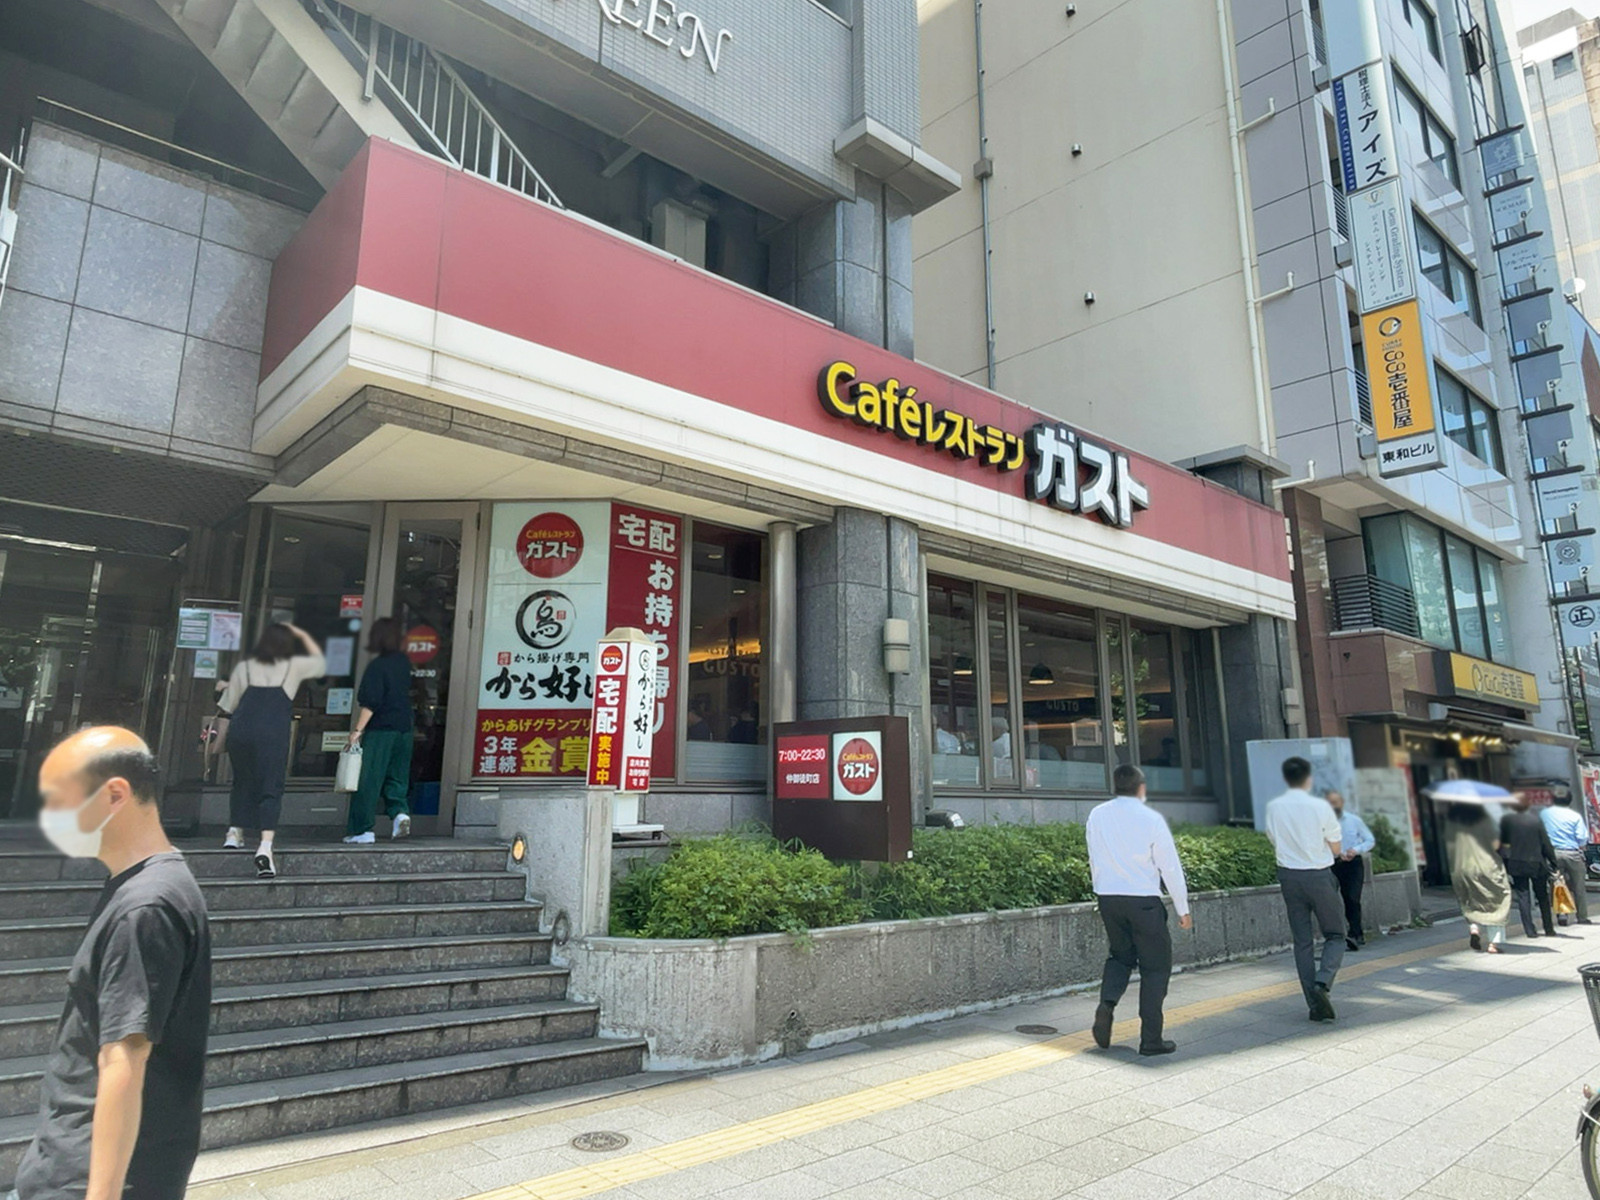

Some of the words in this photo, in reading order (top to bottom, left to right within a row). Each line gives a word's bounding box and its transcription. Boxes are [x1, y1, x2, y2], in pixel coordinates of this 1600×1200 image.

[1358, 109, 1387, 182] アイズ
[826, 361, 1025, 471] Caféレストラン
[1034, 424, 1149, 530] ガスト
[1382, 442, 1436, 465] 東和ビル
[1570, 502, 1578, 511] 3
[618, 513, 676, 553] 宅配
[525, 540, 577, 558] ガスト
[1580, 566, 1589, 575] 2
[407, 642, 436, 653] ガスト
[513, 651, 590, 664] から揚げ専門
[603, 656, 622, 666] ガスト
[485, 664, 593, 703] から好し
[595, 678, 621, 734] 宅配
[483, 735, 518, 755] 3年
[520, 735, 591, 774] 金賞
[479, 755, 517, 774] 連続
[594, 735, 613, 785] 実施中
[843, 762, 875, 778] ガスト
